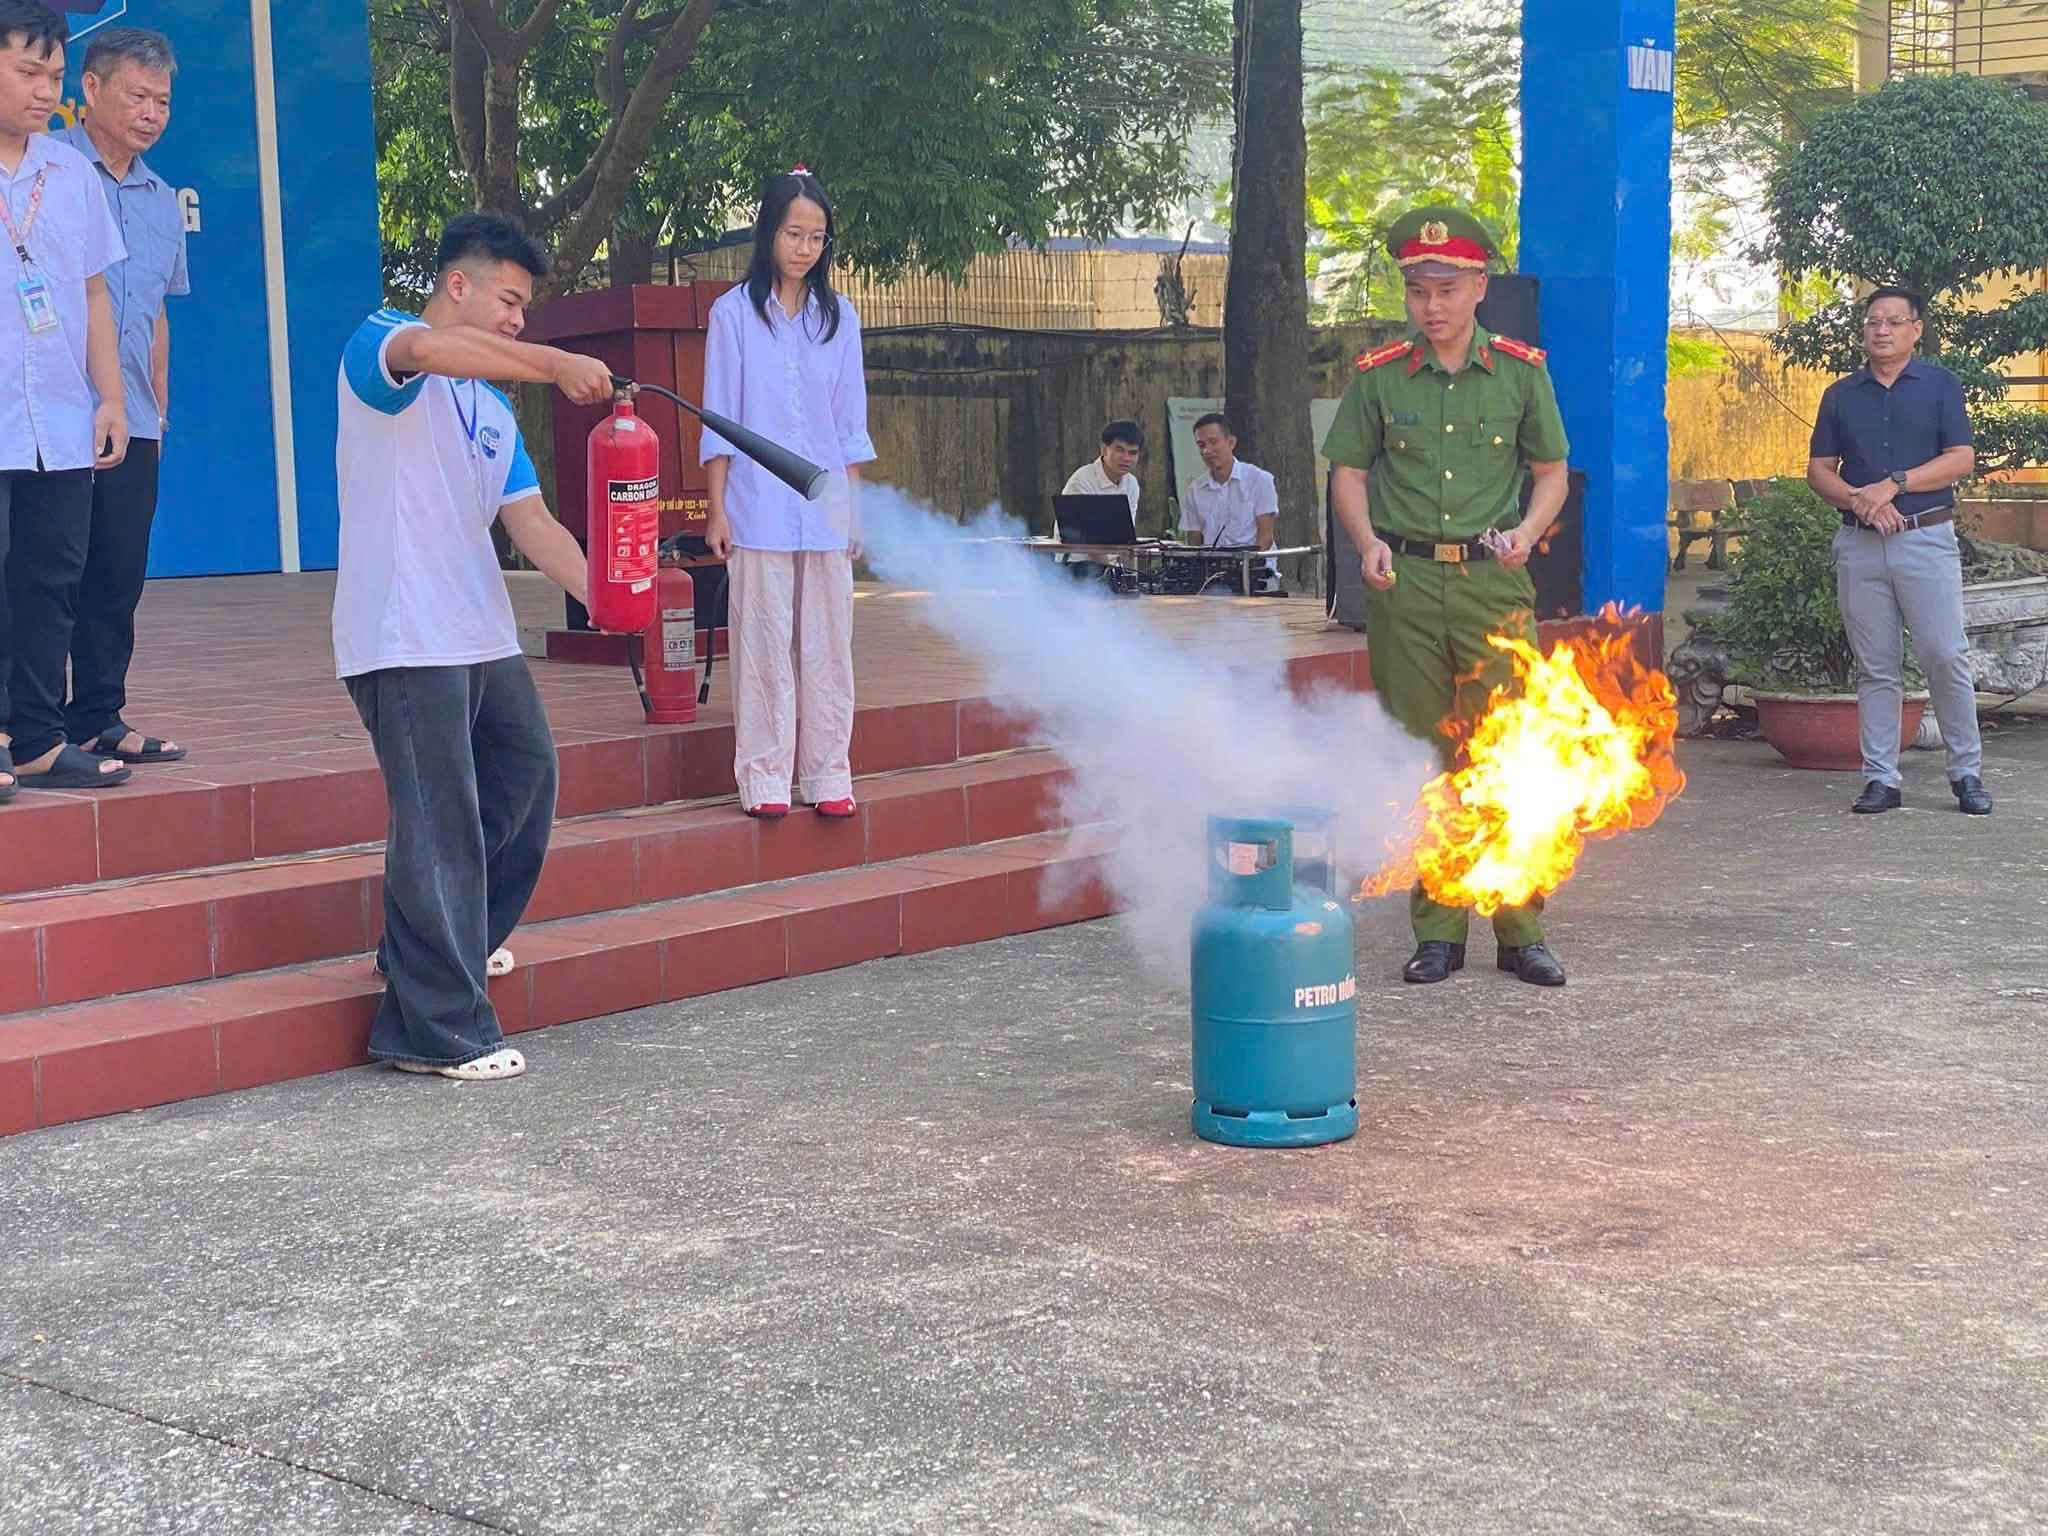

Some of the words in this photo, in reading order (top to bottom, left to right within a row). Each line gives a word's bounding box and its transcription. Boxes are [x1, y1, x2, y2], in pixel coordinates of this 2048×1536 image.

[627, 481, 656, 491] DRAGON
[610, 490, 645, 502] CARBON
[1295, 984, 1336, 1008] PETRO
